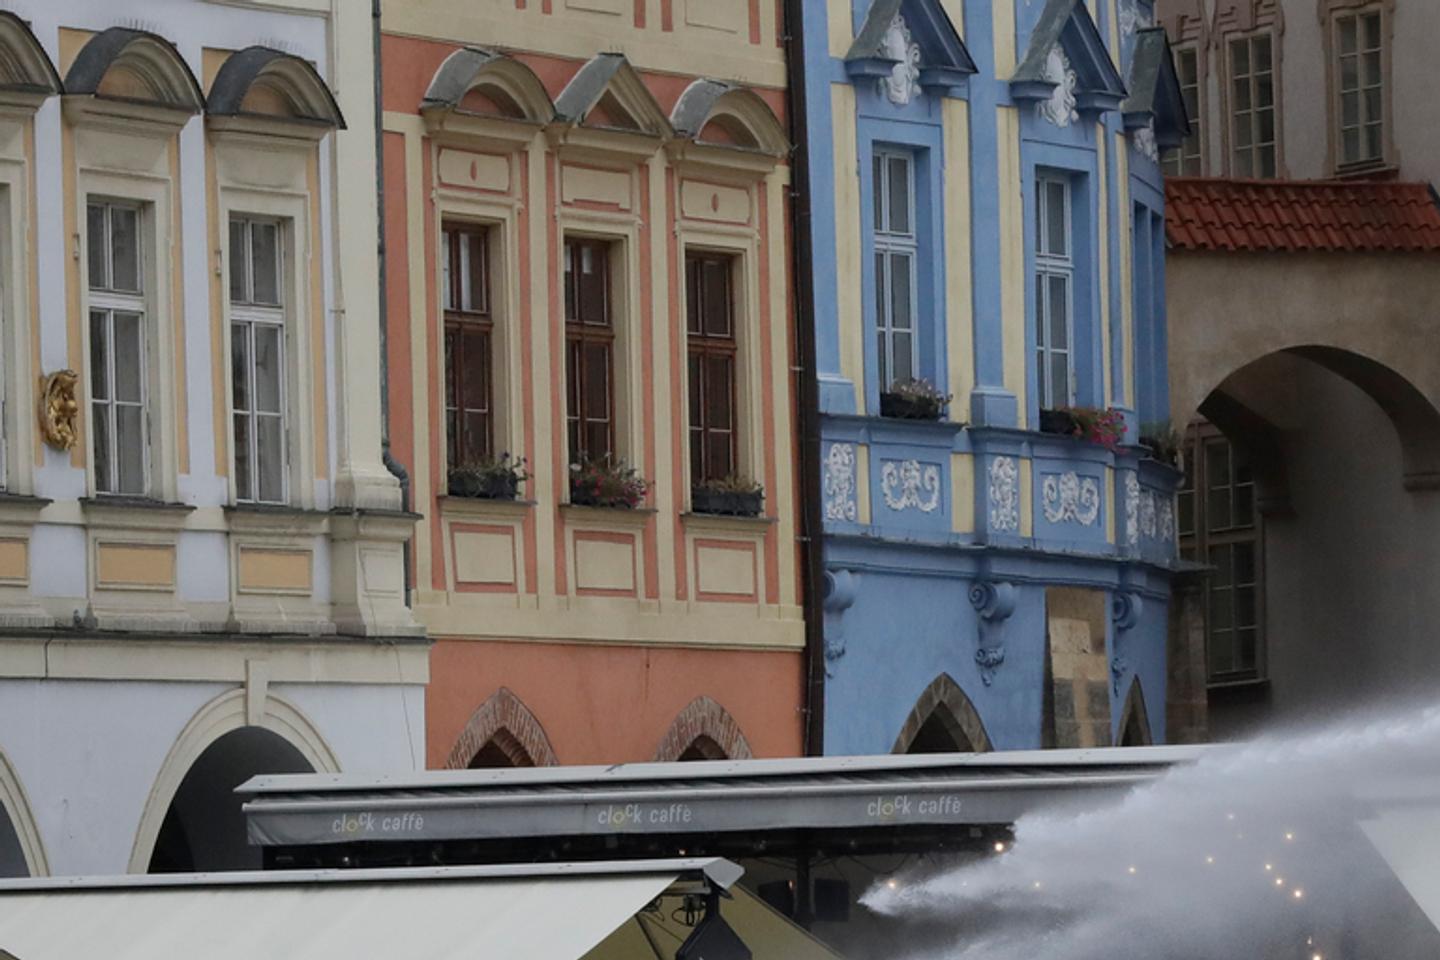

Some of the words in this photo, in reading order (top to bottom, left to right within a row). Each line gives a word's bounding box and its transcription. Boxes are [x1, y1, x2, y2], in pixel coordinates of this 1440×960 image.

[598, 804, 642, 825] clock
[650, 803, 693, 823] caffè
[868, 795, 912, 817] clock
[919, 795, 962, 815] caffè
[332, 812, 376, 833] clock
[382, 812, 424, 831] caffè
